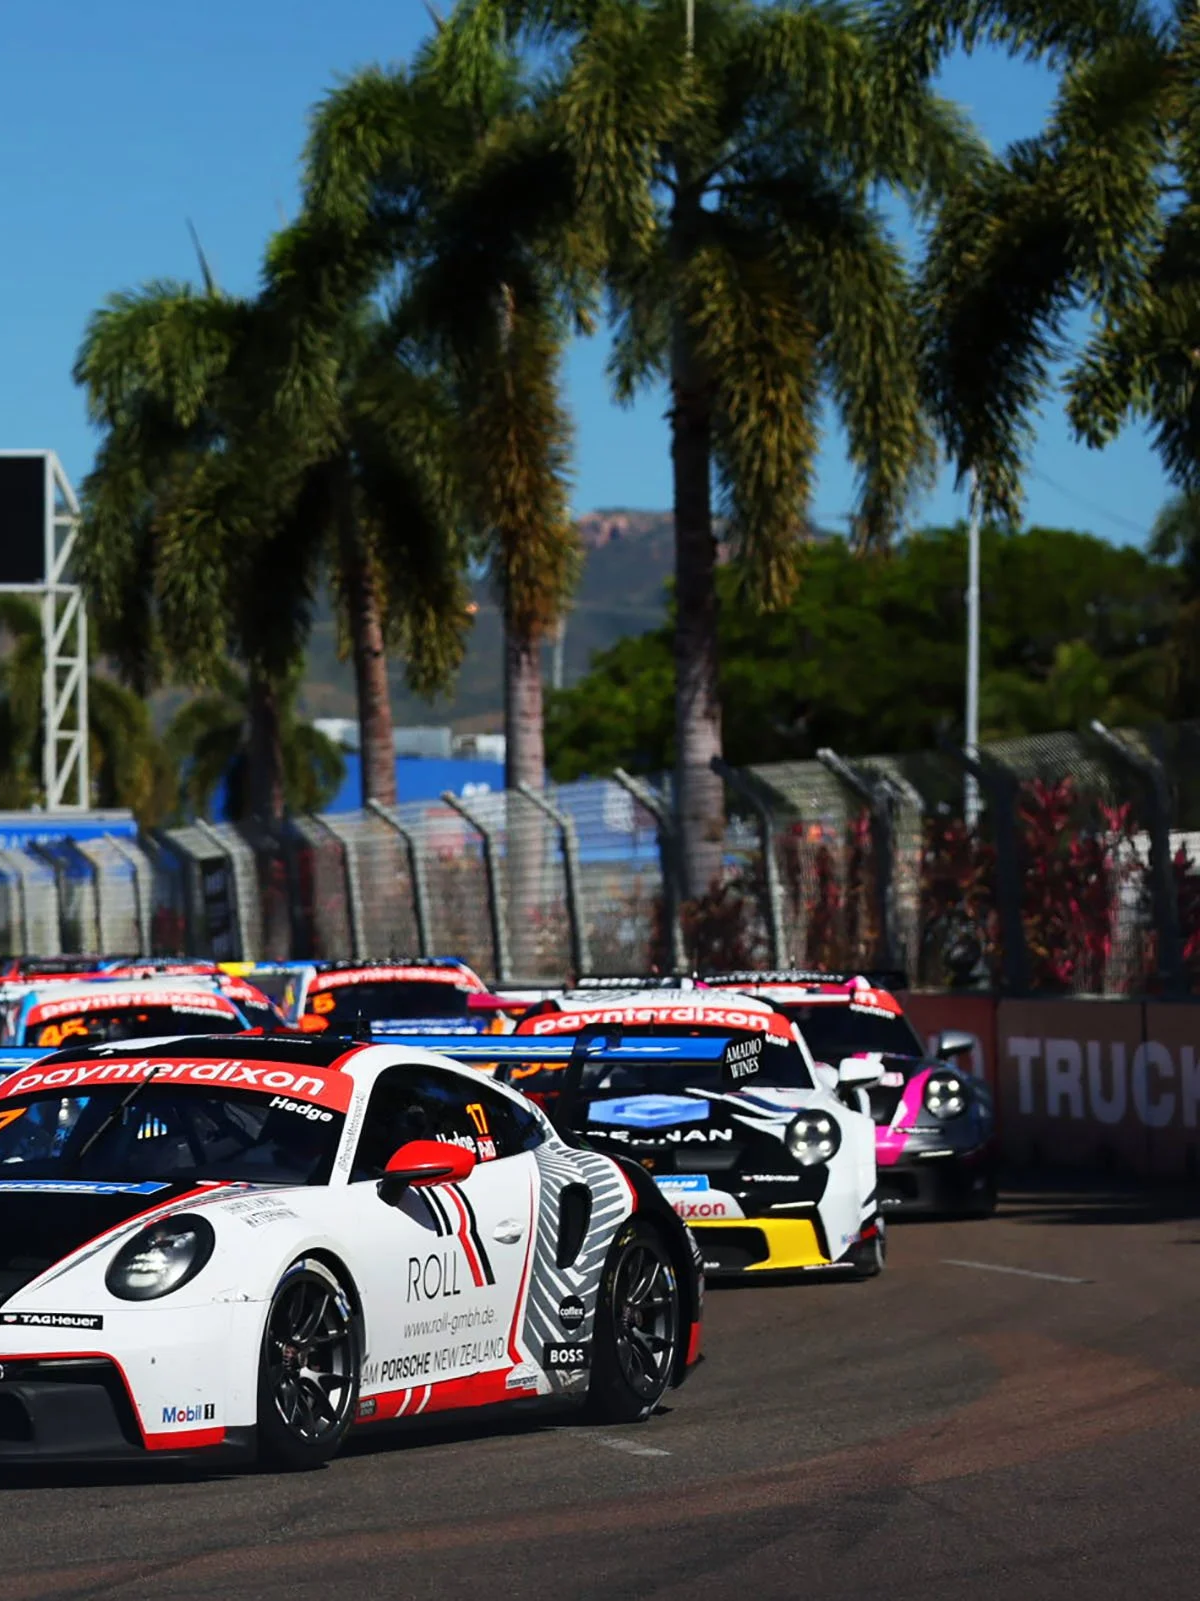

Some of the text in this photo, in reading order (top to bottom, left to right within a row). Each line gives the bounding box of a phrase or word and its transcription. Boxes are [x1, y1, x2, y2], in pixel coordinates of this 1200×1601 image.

[38, 1018, 88, 1047] 45
[534, 1007, 769, 1035] paynterdixon
[726, 1038, 762, 1064] AMADIO
[9, 1060, 326, 1096] paynterdixon
[730, 1056, 760, 1079] WINES
[269, 1096, 334, 1123] Hedge
[466, 1103, 489, 1134] 17
[406, 1250, 461, 1303] ROLL
[380, 1351, 431, 1383] PORSCHE
[433, 1346, 461, 1373] NEW
[460, 1336, 506, 1366] ZEALAND
[550, 1348, 585, 1363] BOSS
[161, 1404, 202, 1424] Mobil
